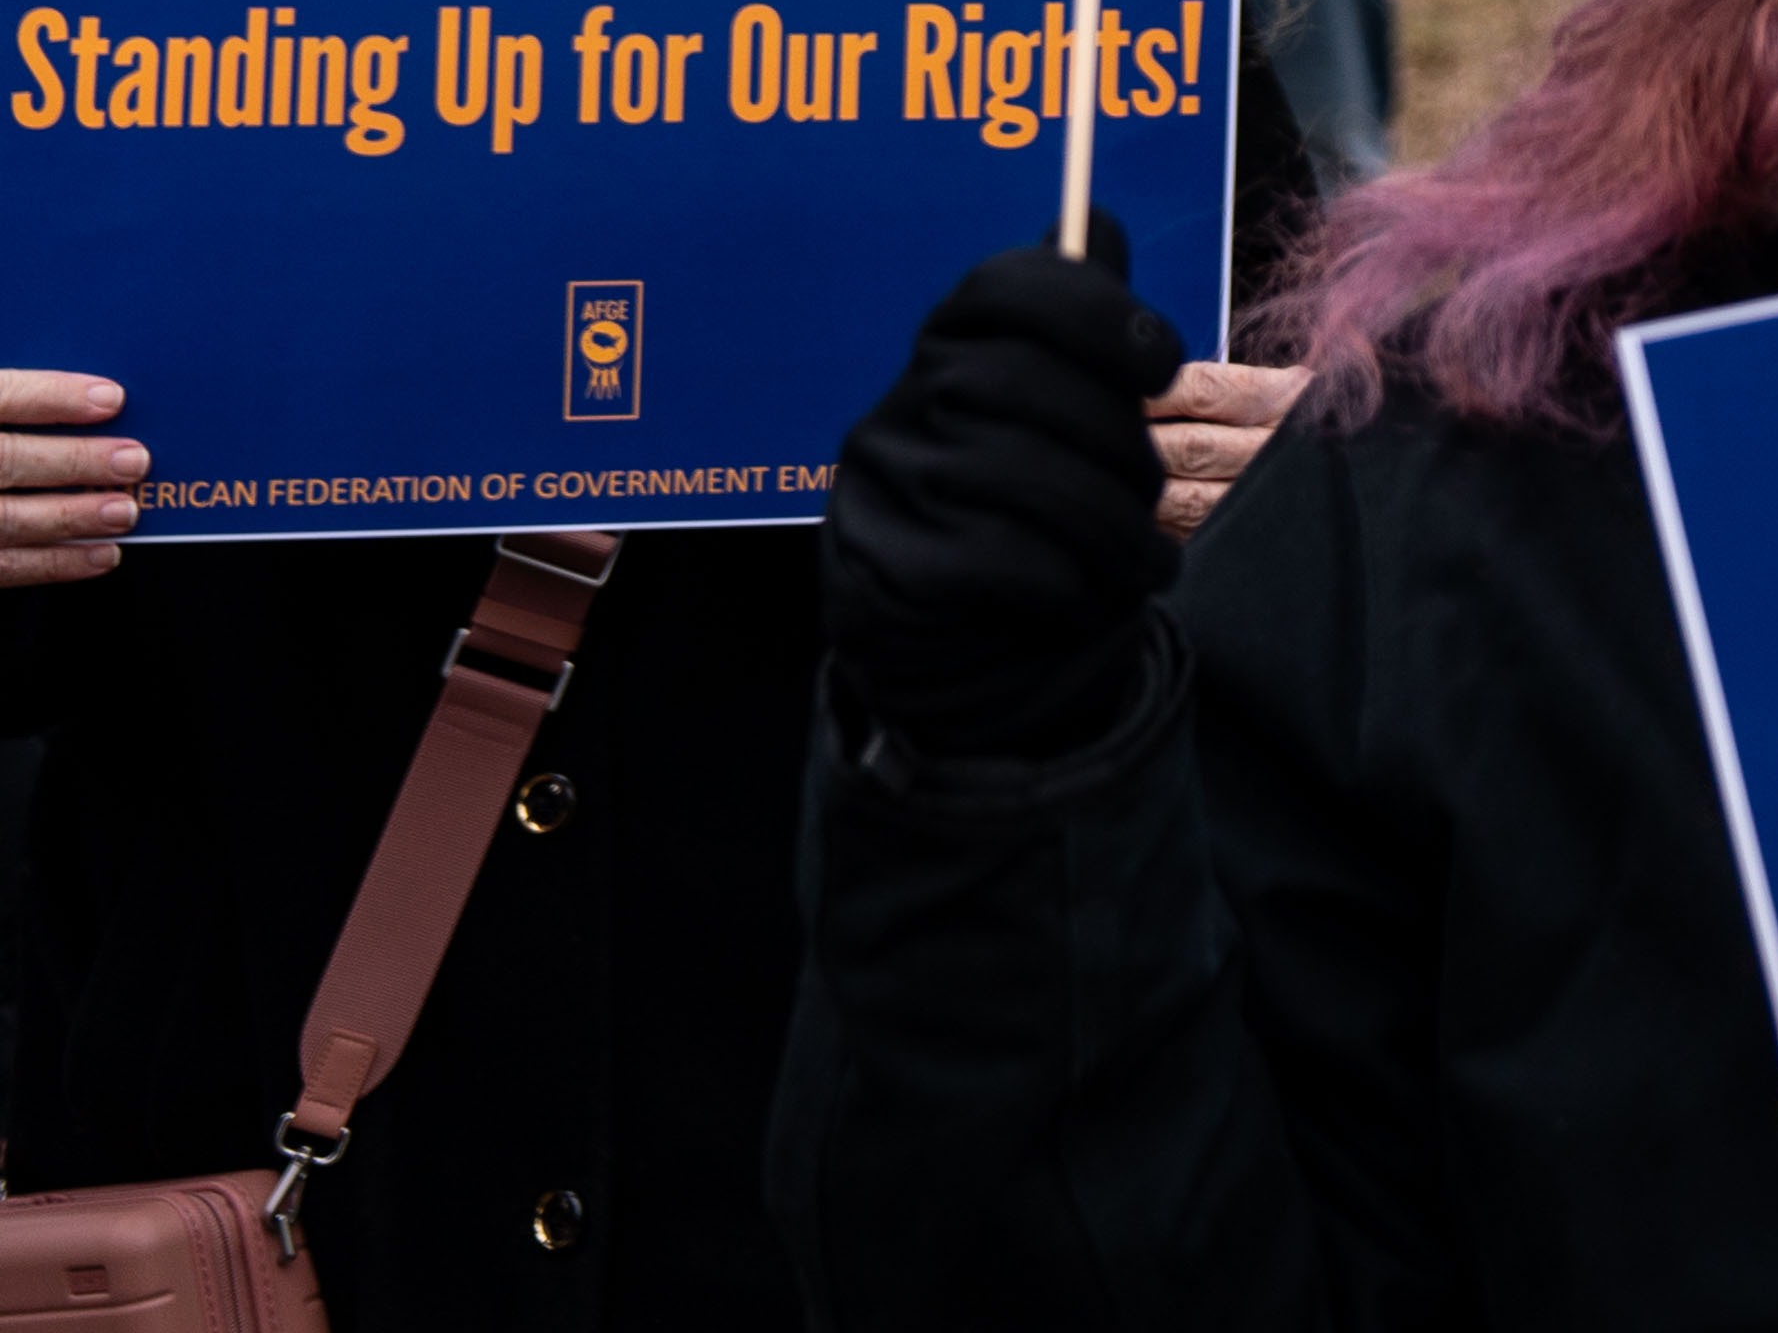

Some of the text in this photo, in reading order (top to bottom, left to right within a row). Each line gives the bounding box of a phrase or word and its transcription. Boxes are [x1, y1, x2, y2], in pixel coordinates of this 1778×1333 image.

[12, 8, 408, 155] Standing
[437, 7, 541, 153] Up
[574, 6, 702, 123] for
[730, 4, 876, 122] Our
[582, 300, 630, 321] AFGE
[128, 480, 258, 510] ERICAN
[268, 474, 471, 506] FEDERATION
[482, 473, 525, 500] OF
[534, 465, 769, 500] GOVERNMENT
